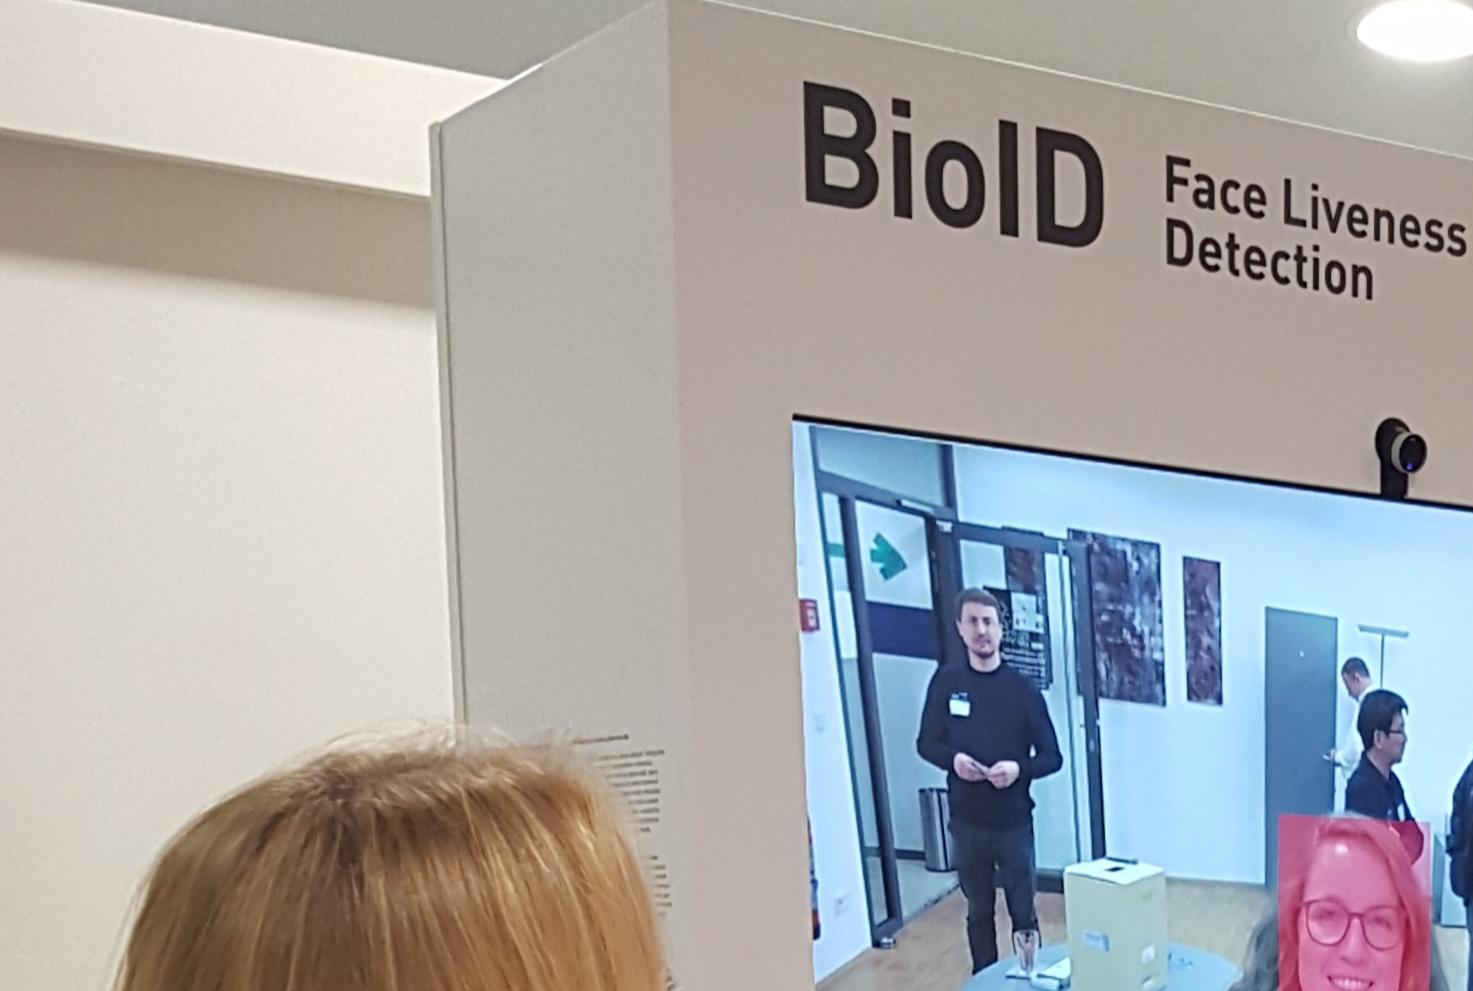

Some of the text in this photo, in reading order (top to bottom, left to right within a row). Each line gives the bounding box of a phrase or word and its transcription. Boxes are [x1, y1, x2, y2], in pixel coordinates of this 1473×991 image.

[803, 80, 1104, 249] BioID
[1166, 155, 1467, 257] Face Liveness
[1166, 218, 1375, 300] Detection
